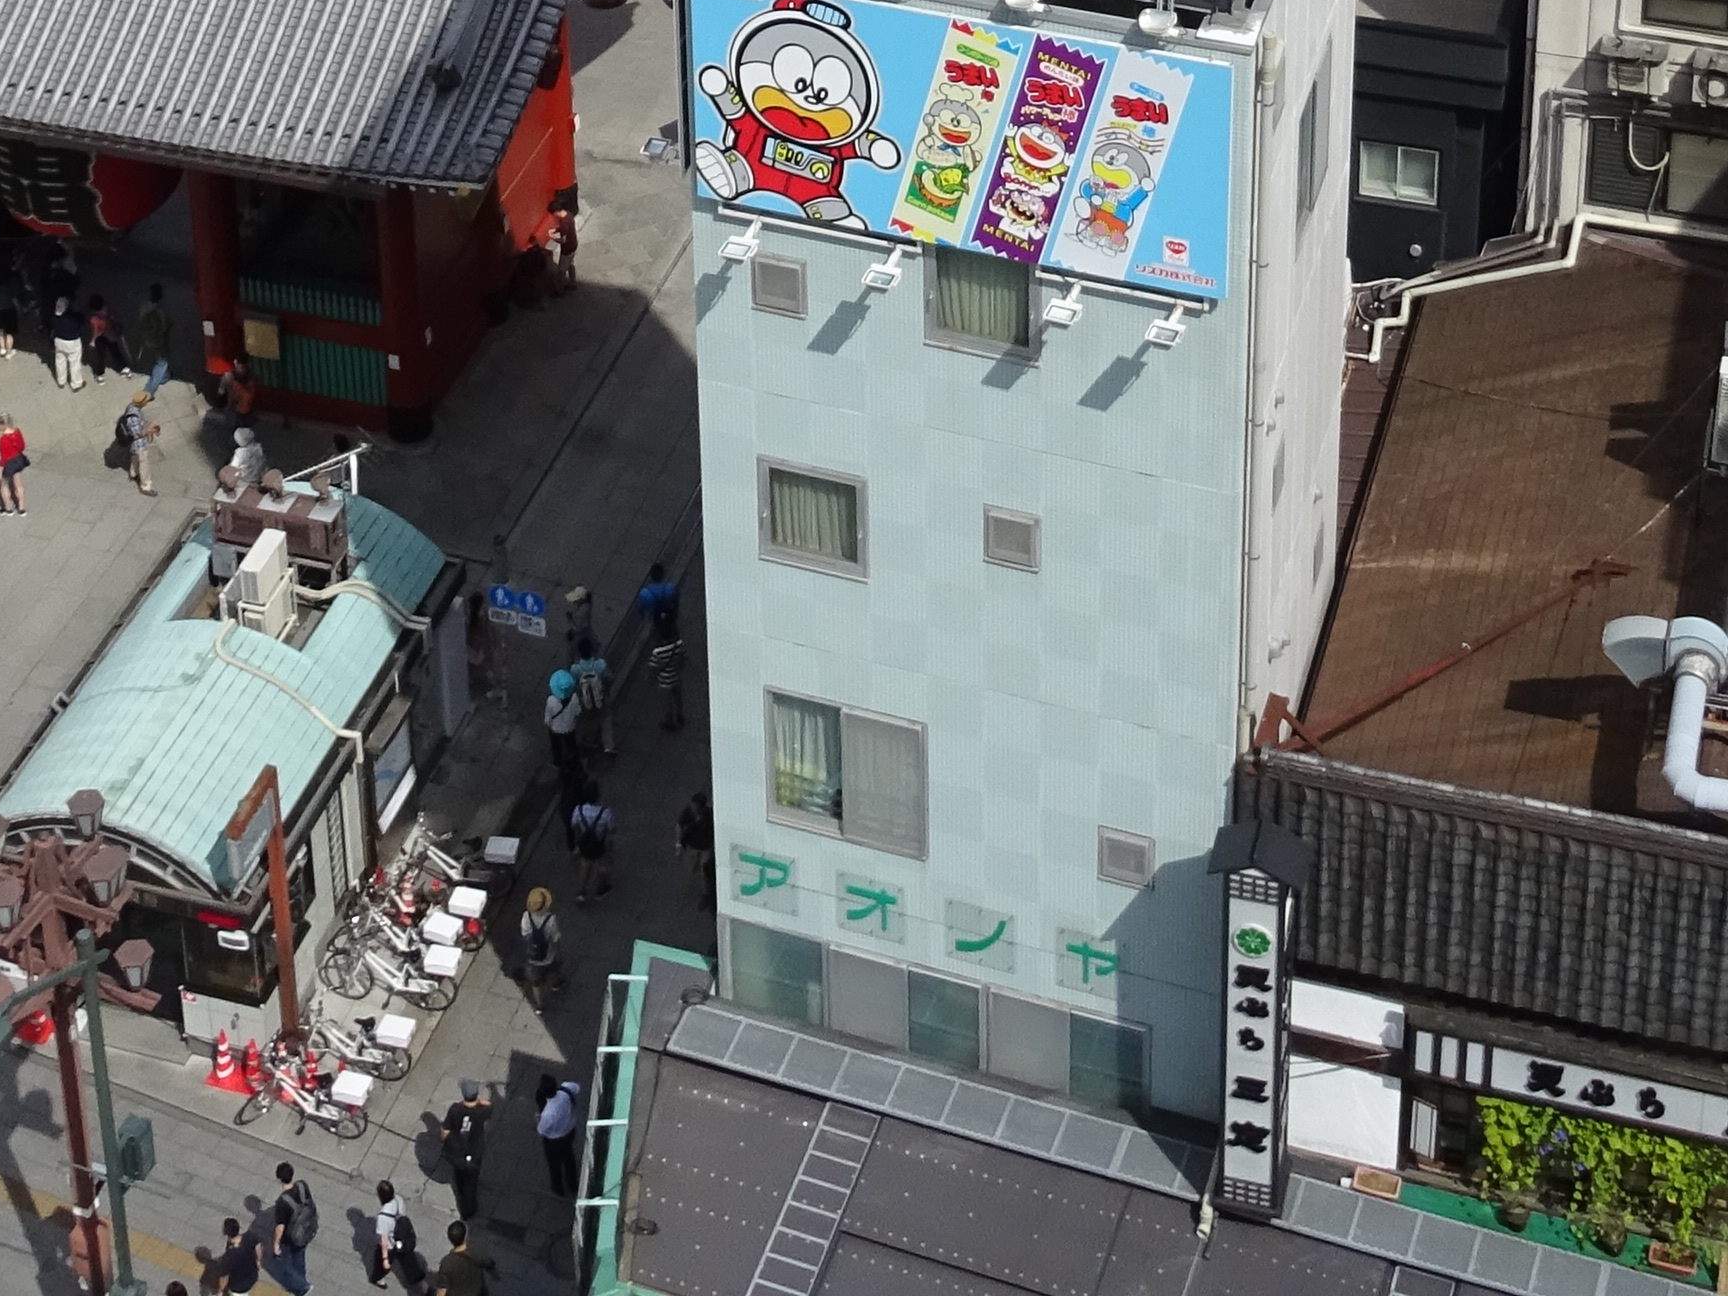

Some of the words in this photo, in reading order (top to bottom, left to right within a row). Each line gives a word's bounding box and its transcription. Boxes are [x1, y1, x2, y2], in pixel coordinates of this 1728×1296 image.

[944, 59, 1001, 89] うまい
[1037, 51, 1092, 81] MENTAI
[1024, 79, 1084, 109] うまい
[1111, 94, 1169, 125] うまい
[982, 223, 1035, 252] MENTAI
[738, 851, 1120, 986] アオノヤ
[1226, 1074, 1272, 1155] 三定
